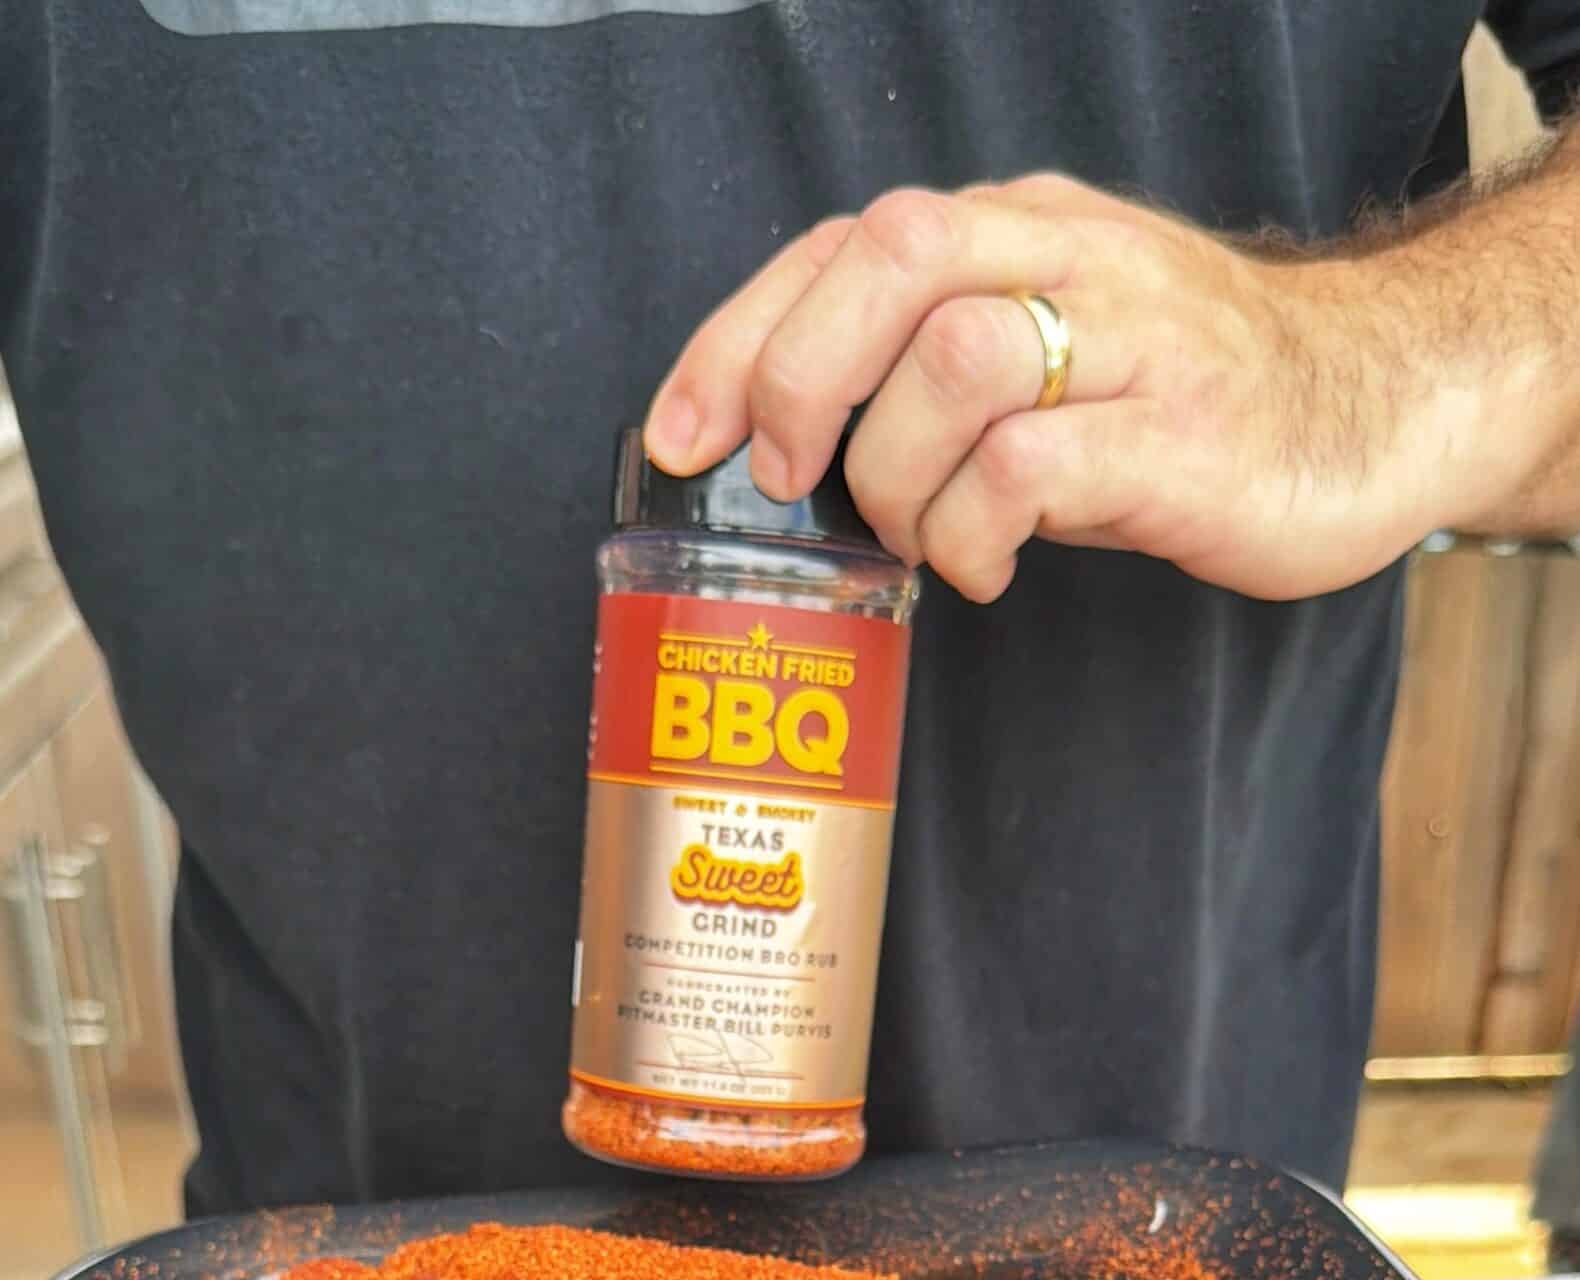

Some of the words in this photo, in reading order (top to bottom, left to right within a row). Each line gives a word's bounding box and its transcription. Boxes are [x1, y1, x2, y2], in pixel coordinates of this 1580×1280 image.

[657, 642, 777, 679] CHICKEN
[782, 655, 855, 687] FRIED
[651, 672, 850, 776] BBQ
[672, 795, 727, 813] SWEET
[701, 824, 784, 851] TEXAS
[674, 845, 801, 909] Sweet
[692, 911, 777, 938] GRIND
[624, 932, 753, 961] COMPETITION
[806, 953, 838, 968] RUB
[638, 989, 705, 1010] GRAND
[710, 999, 815, 1019] CHAMPION
[666, 977, 767, 997] HANDCRAFTED
[773, 987, 791, 998] BY
[617, 1004, 720, 1030] PITMASTER
[723, 1018, 765, 1036] BILL
[770, 1023, 833, 1040] PURVIS
